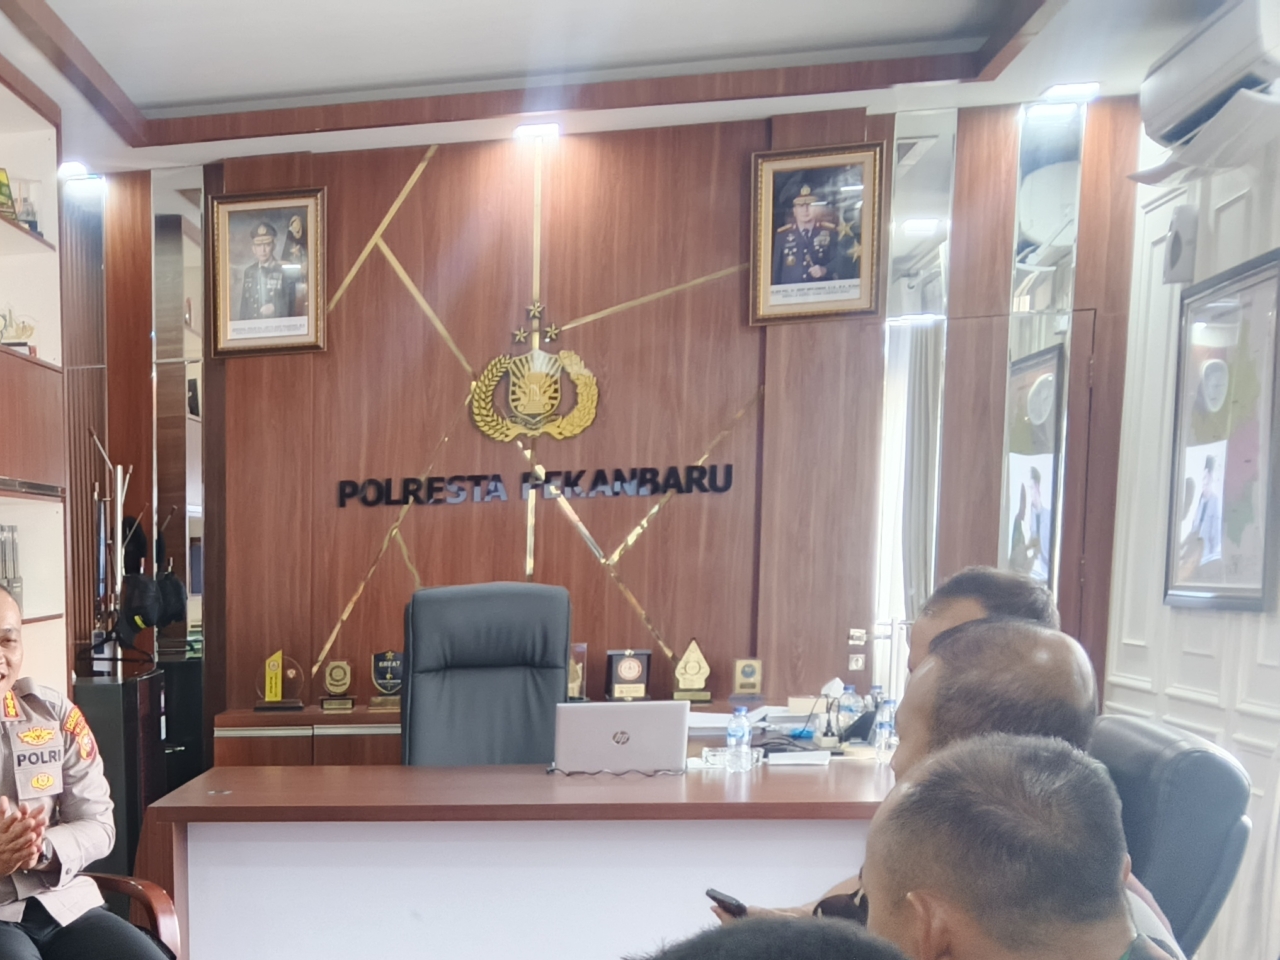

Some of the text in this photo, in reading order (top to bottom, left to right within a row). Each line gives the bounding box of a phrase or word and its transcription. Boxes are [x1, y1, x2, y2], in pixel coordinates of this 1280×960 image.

[338, 463, 734, 508] POLRESTA PEKANBARU
[16, 749, 61, 767] POLRI
